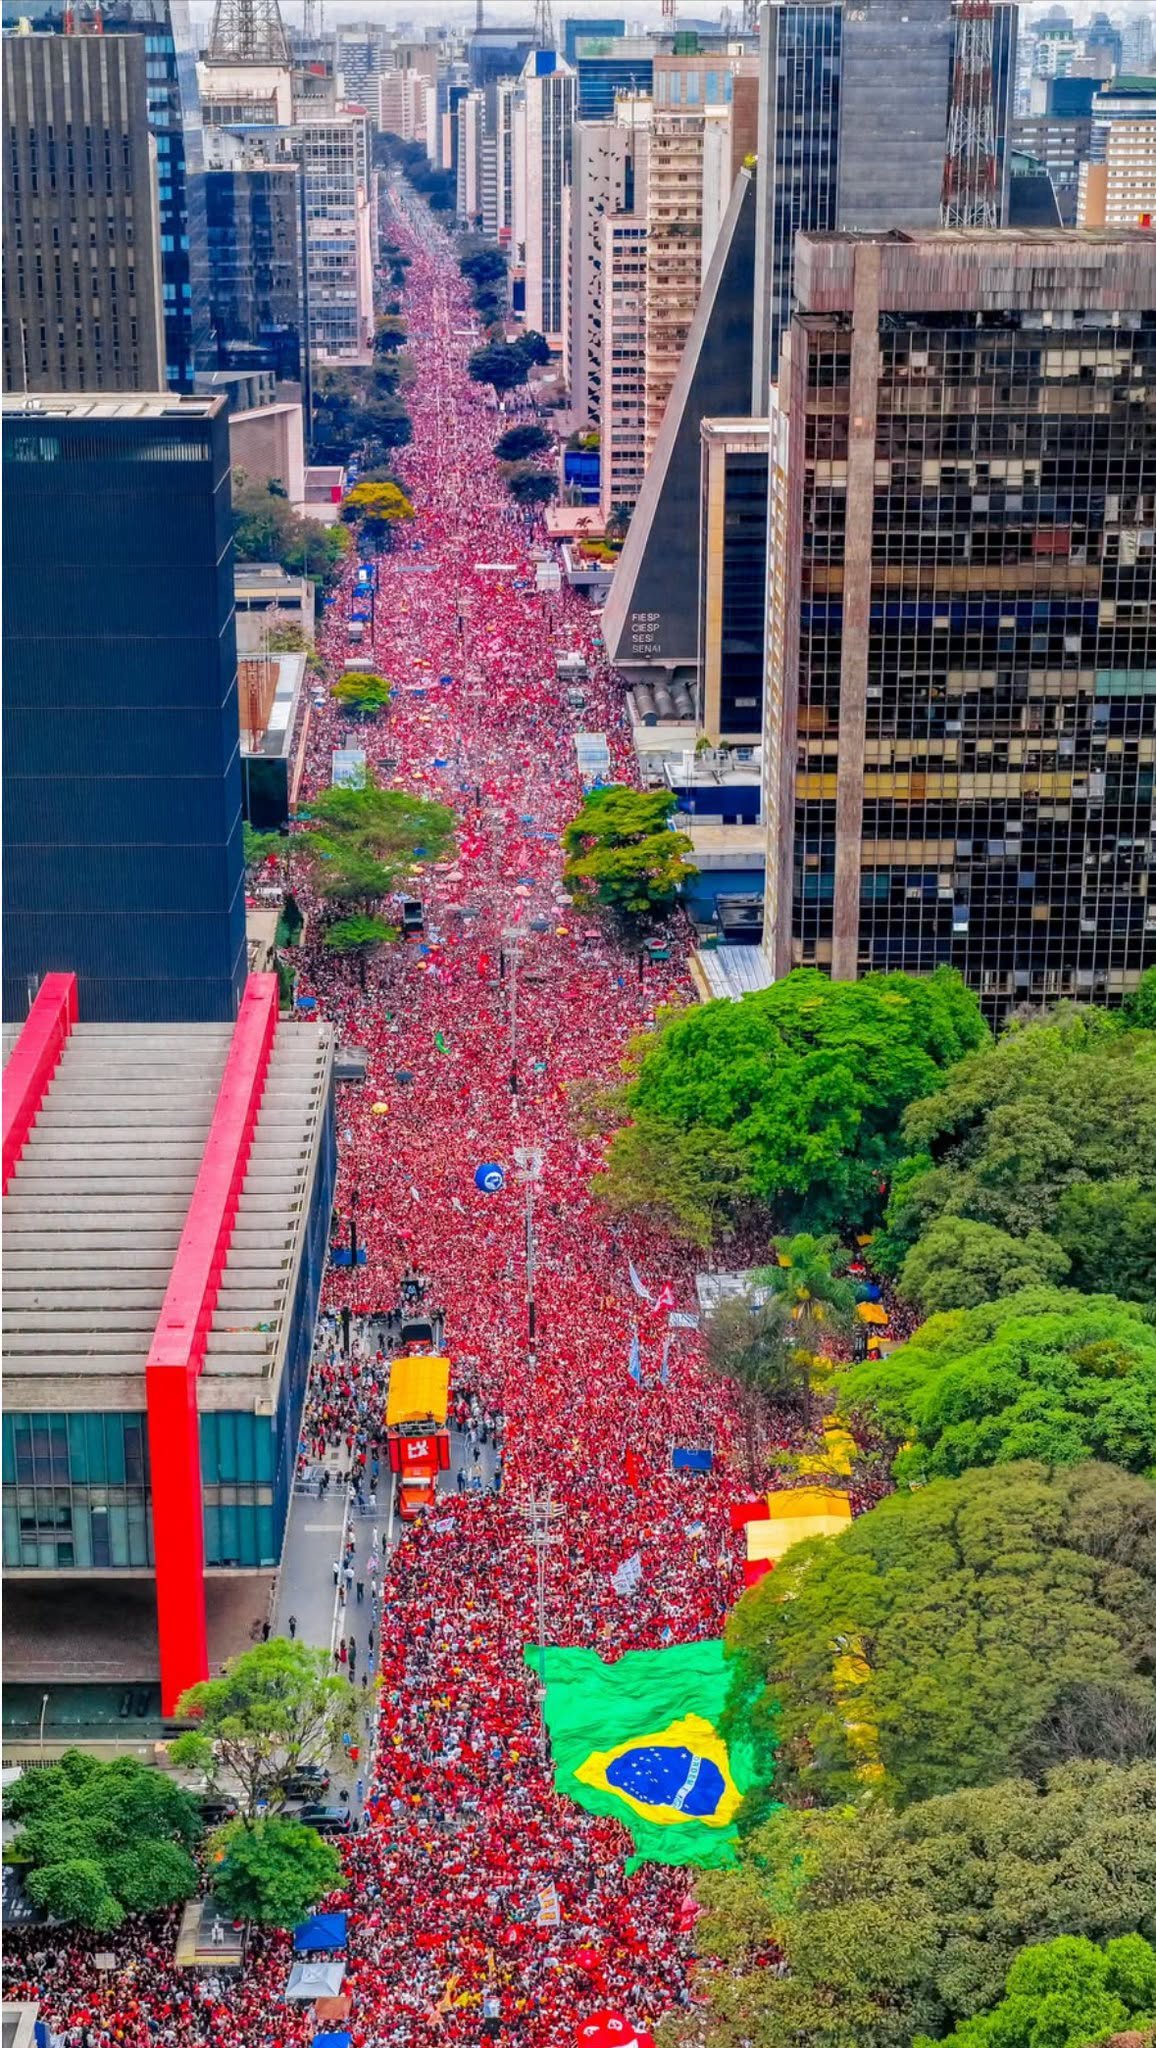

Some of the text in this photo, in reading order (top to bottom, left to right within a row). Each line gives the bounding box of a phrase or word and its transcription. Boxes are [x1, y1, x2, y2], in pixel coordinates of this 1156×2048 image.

[632, 613, 660, 621] FIESP
[632, 624, 660, 632] CIESP
[632, 634, 655, 642] SESI
[632, 645, 661, 653] SENAI
